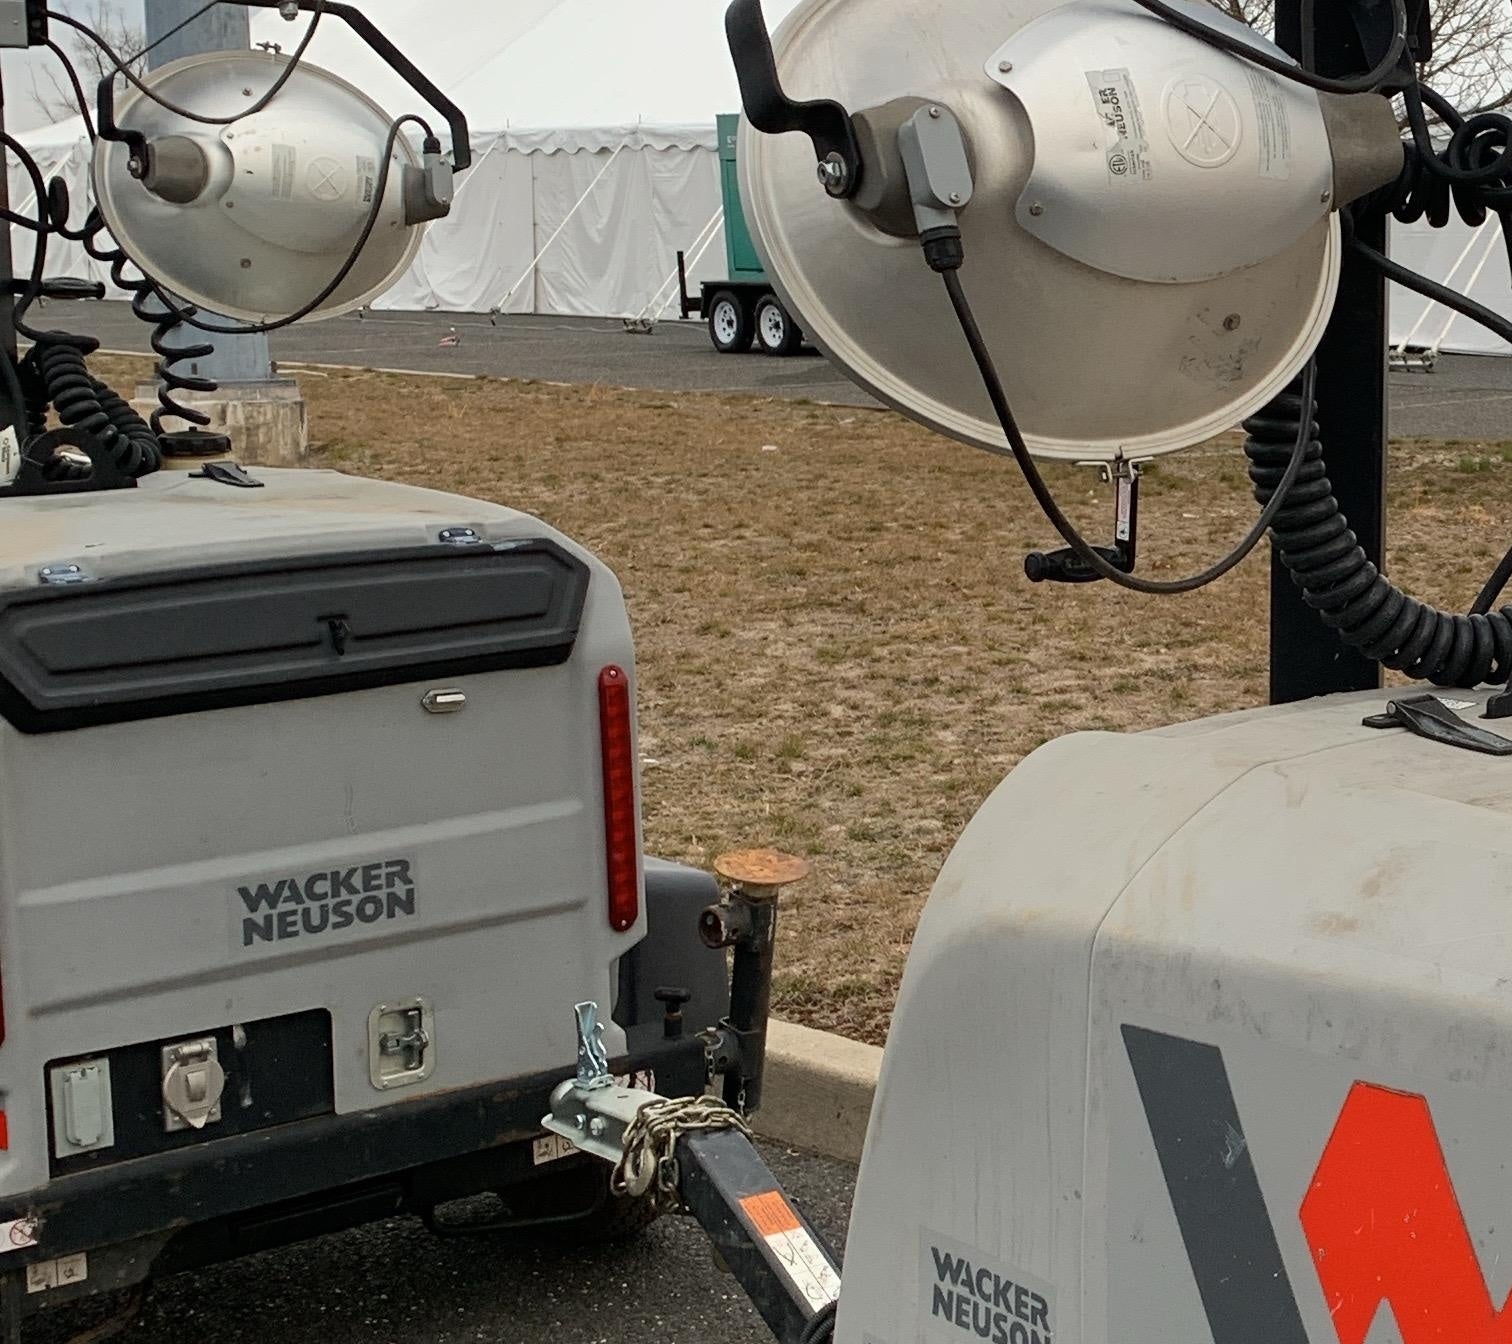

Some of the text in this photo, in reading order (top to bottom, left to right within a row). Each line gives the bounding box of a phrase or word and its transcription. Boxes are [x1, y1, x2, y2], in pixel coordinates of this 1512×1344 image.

[237, 859, 414, 913] WACKER
[242, 888, 415, 946] NEUSON
[931, 1246, 1050, 1332] WACKER
